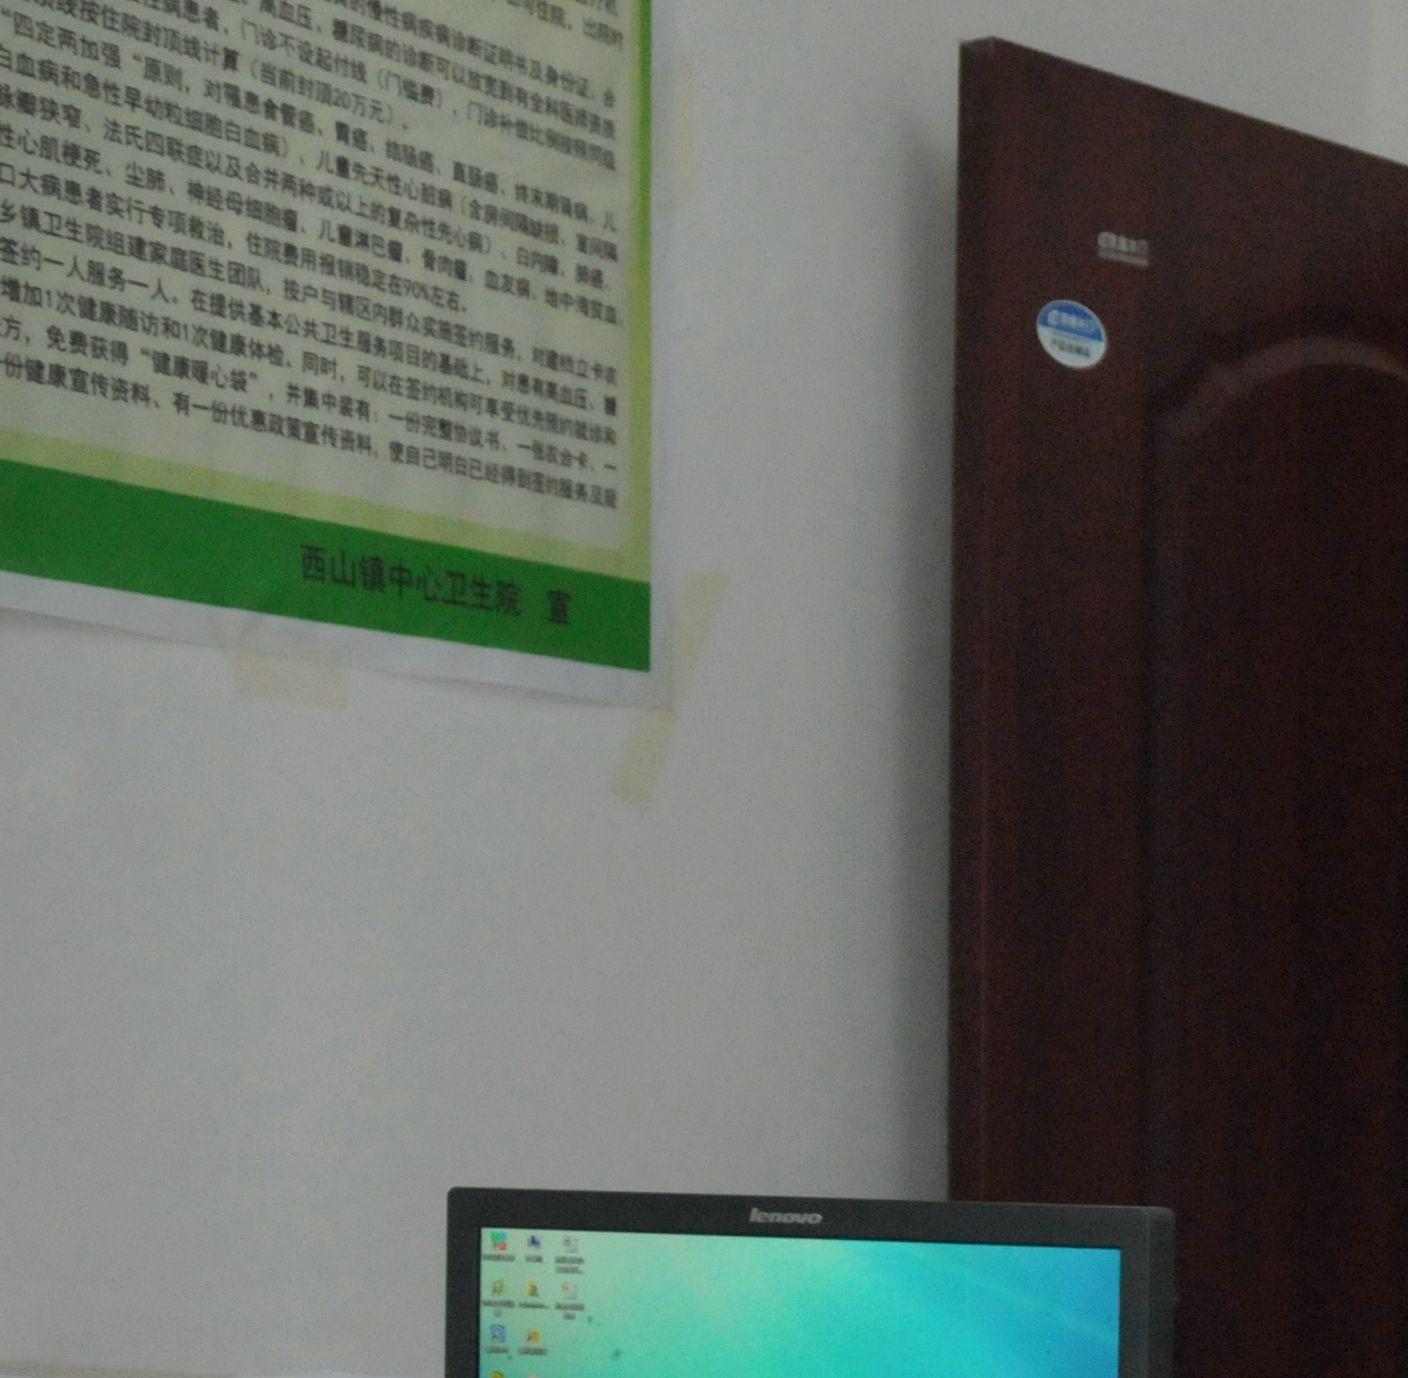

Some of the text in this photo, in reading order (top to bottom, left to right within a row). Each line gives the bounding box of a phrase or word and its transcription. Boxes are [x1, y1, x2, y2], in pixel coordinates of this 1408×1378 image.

[301, 543, 521, 616] 西山镇中心卫生院
